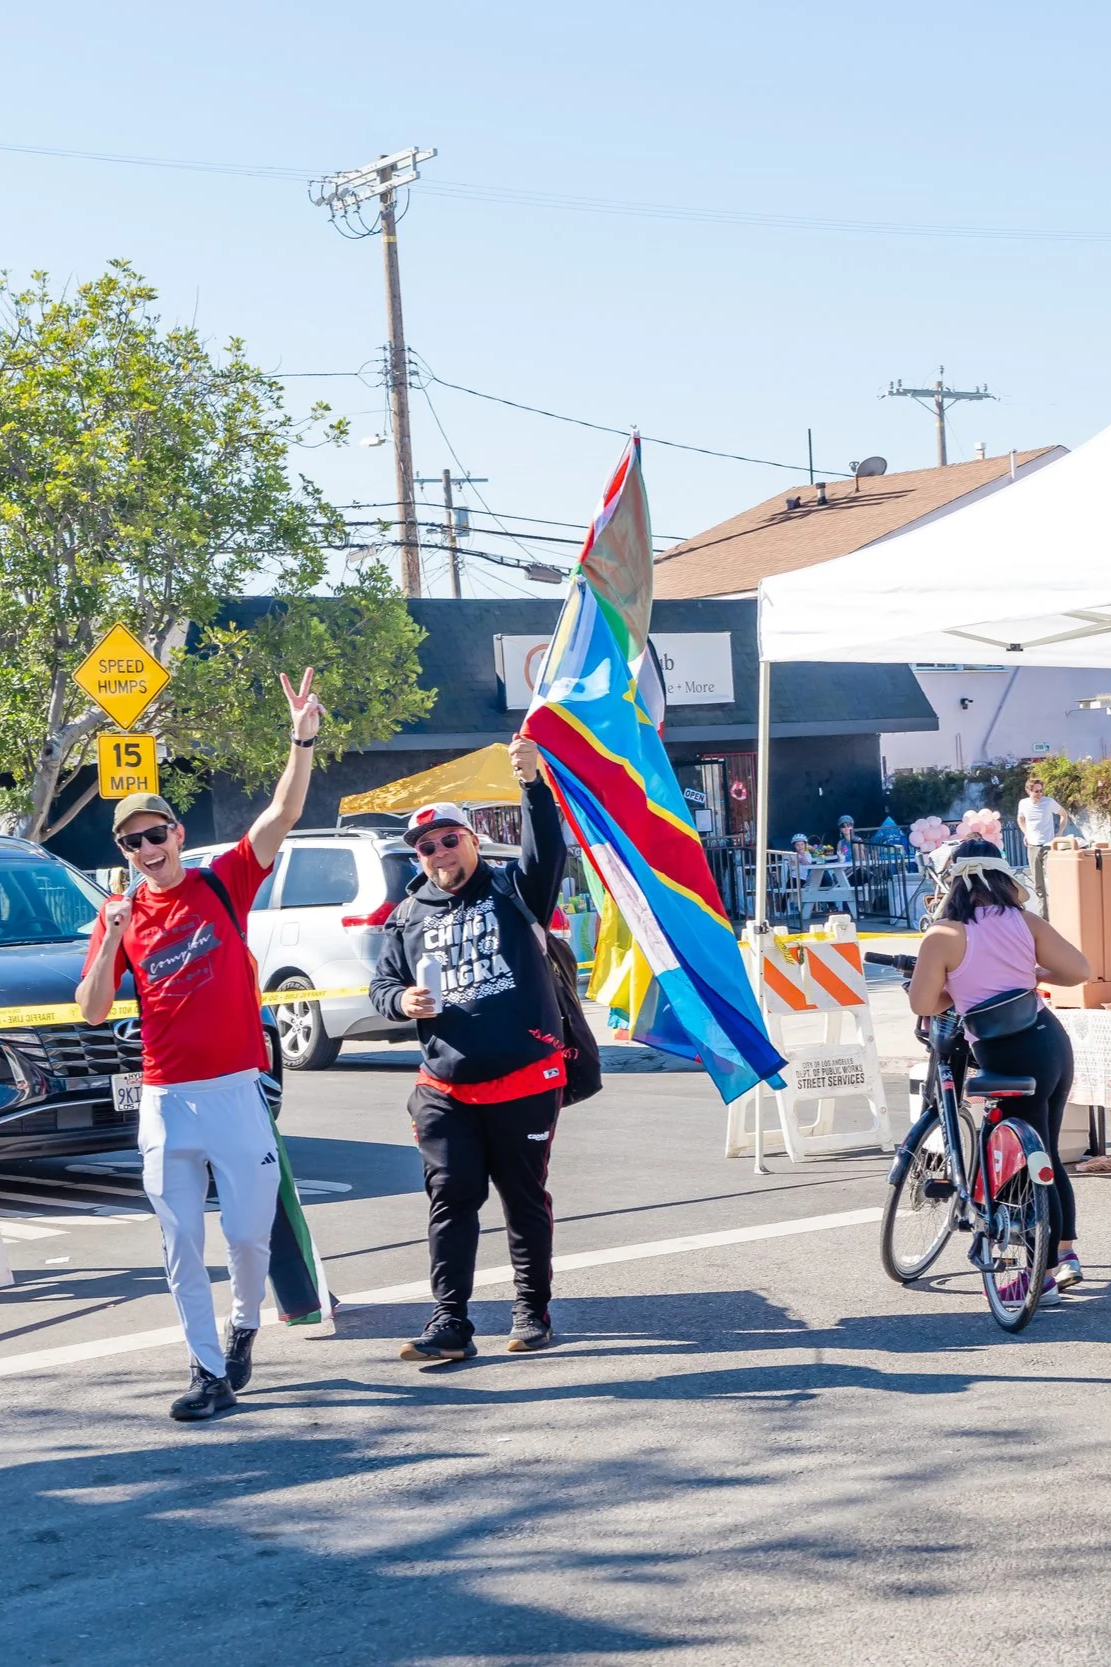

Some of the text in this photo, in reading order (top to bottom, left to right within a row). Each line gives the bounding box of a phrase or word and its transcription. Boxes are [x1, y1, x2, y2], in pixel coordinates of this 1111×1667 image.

[99, 659, 144, 673] SPEED
[97, 679, 148, 694] HUMPS
[685, 681, 715, 693] More
[113, 743, 142, 768] 15
[110, 776, 148, 790] MPH
[685, 790, 705, 802] OPEN
[813, 1068, 820, 1076] OF
[821, 1066, 841, 1076] PUBLIC
[842, 1064, 863, 1073] WORKS
[821, 1059, 831, 1067] LOS
[797, 1073, 865, 1089] STREET SERVICES
